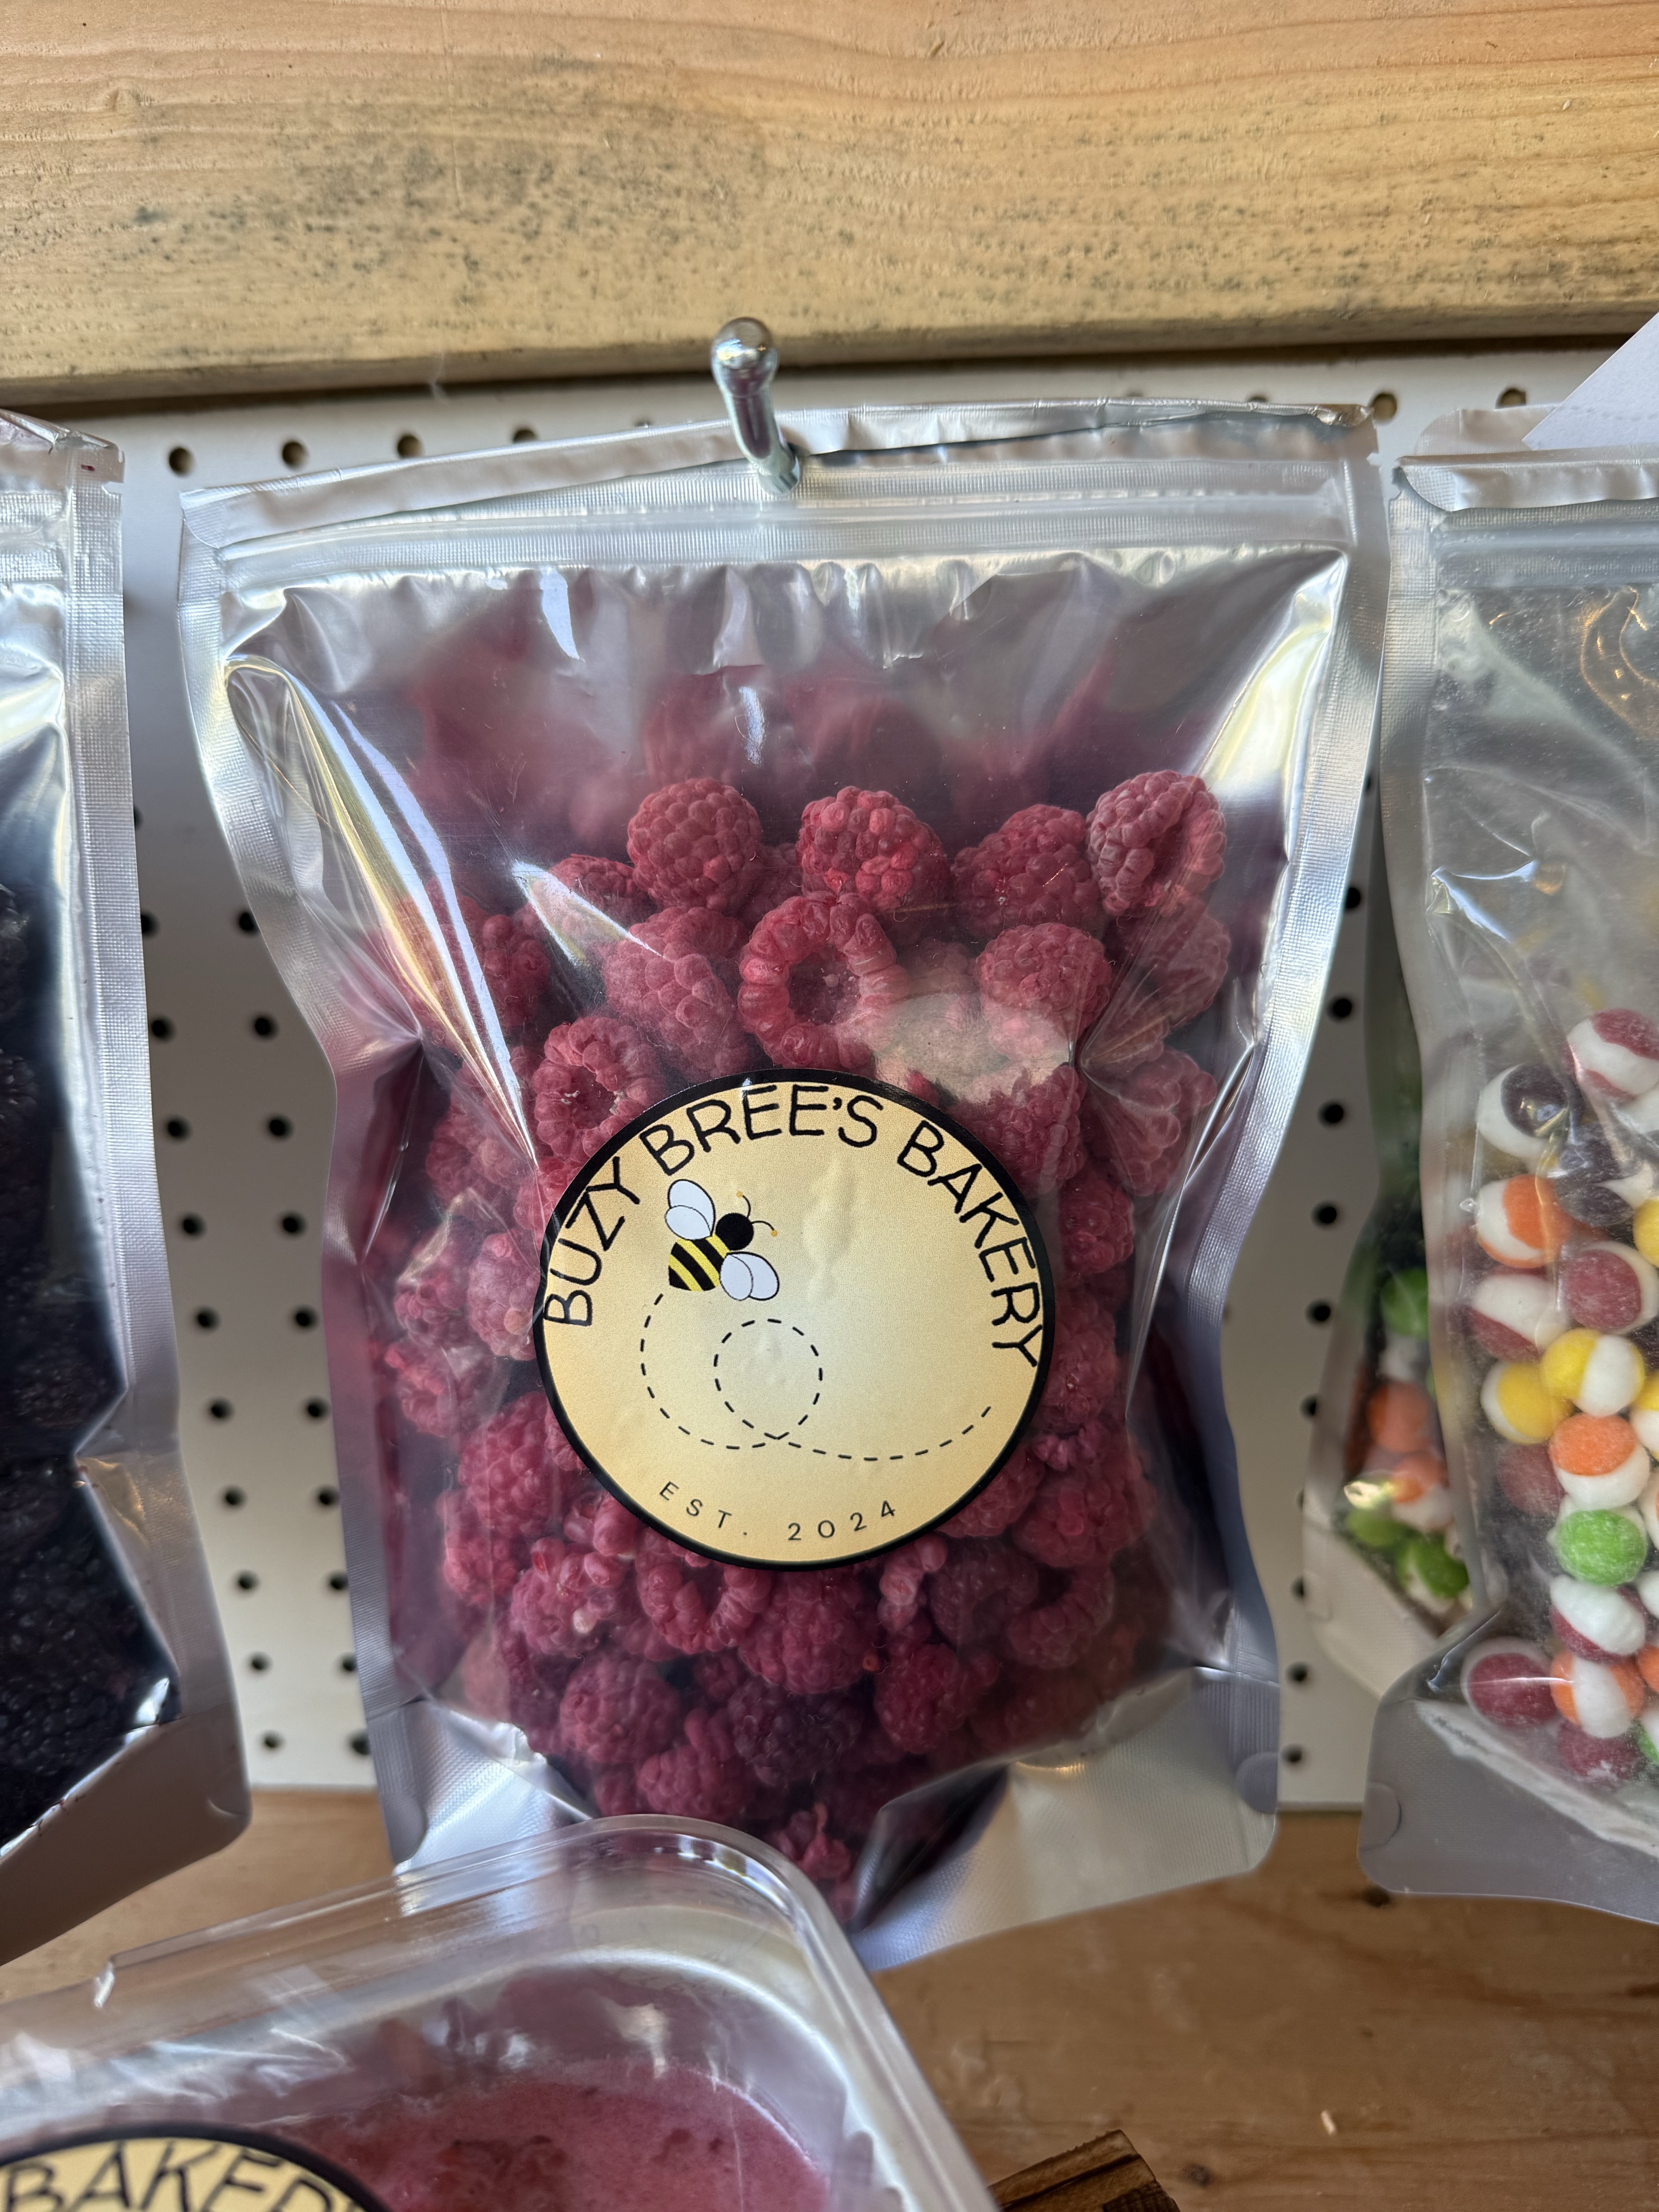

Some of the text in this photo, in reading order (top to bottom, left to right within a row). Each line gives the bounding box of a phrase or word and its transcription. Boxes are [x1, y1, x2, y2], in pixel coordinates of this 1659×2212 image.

[543, 1084, 1043, 1367] BUZY BREE'S BAKERY
[659, 1480, 895, 1541] EST. 2024
